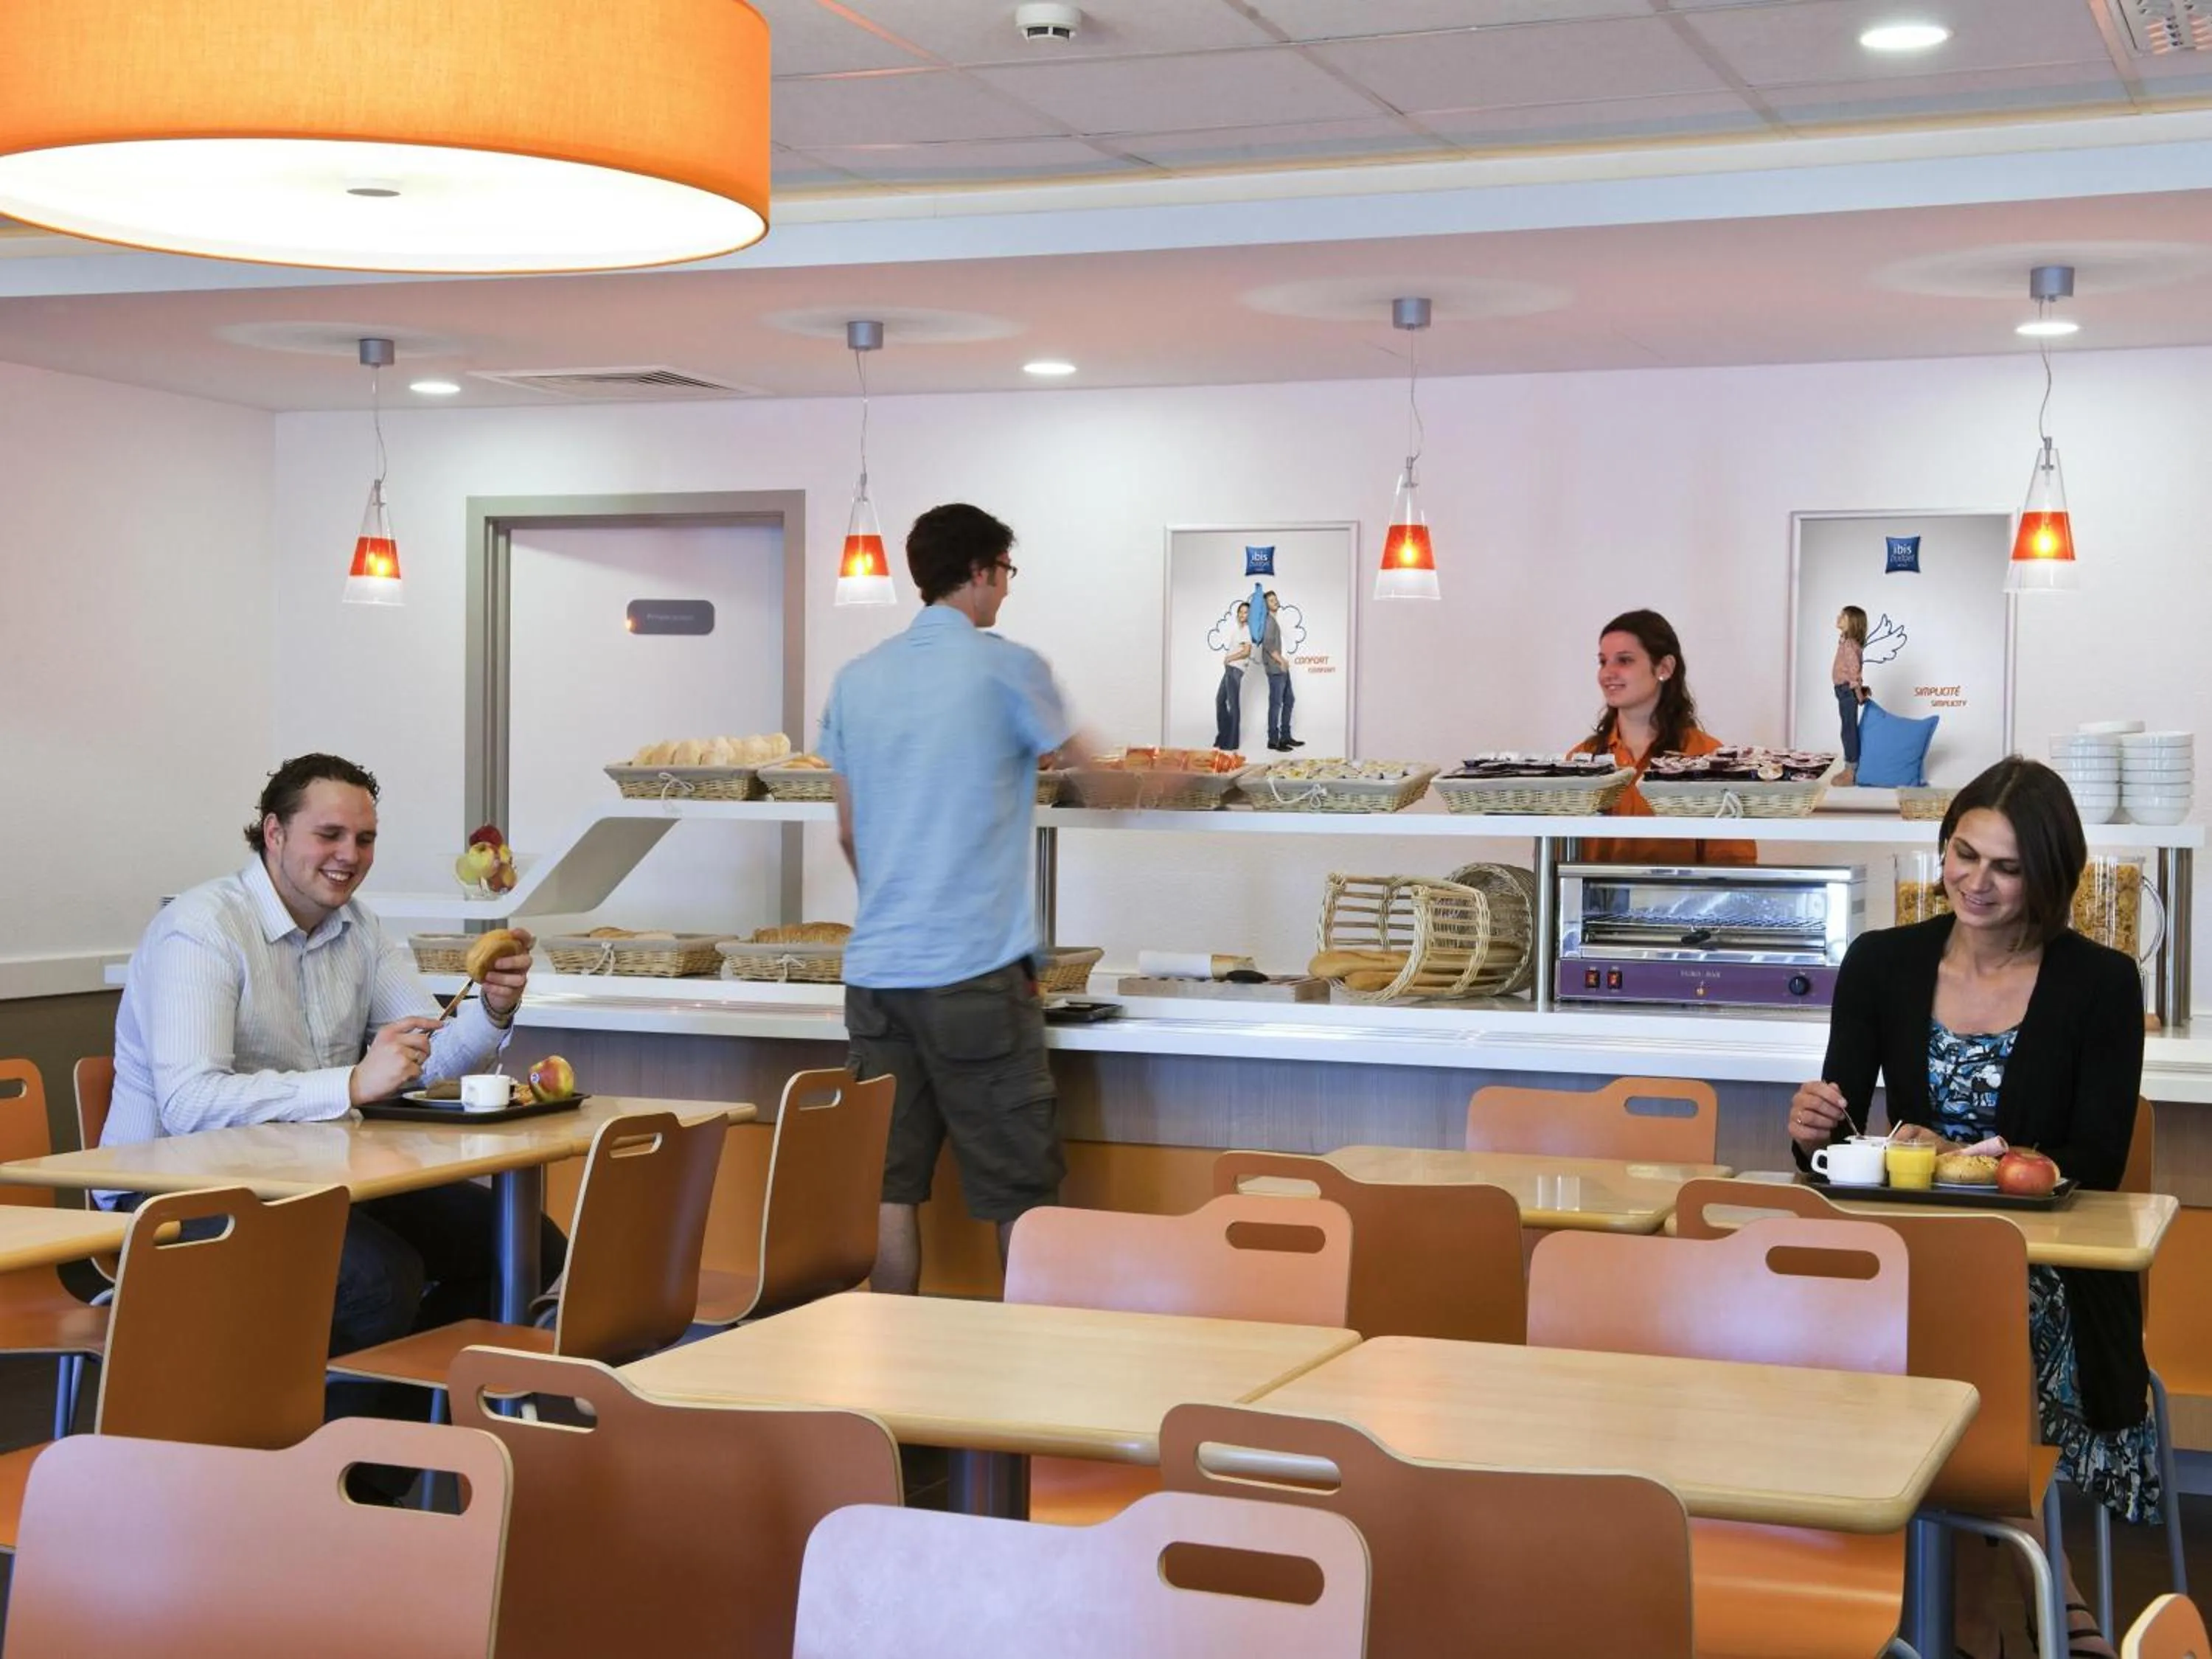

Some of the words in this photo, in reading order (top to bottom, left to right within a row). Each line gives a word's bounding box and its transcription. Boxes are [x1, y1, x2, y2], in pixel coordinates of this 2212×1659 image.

[1893, 543, 1912, 554] ibis
[1251, 551, 1267, 560] ibis
[1914, 685, 1961, 697] SIMPLICITÉ
